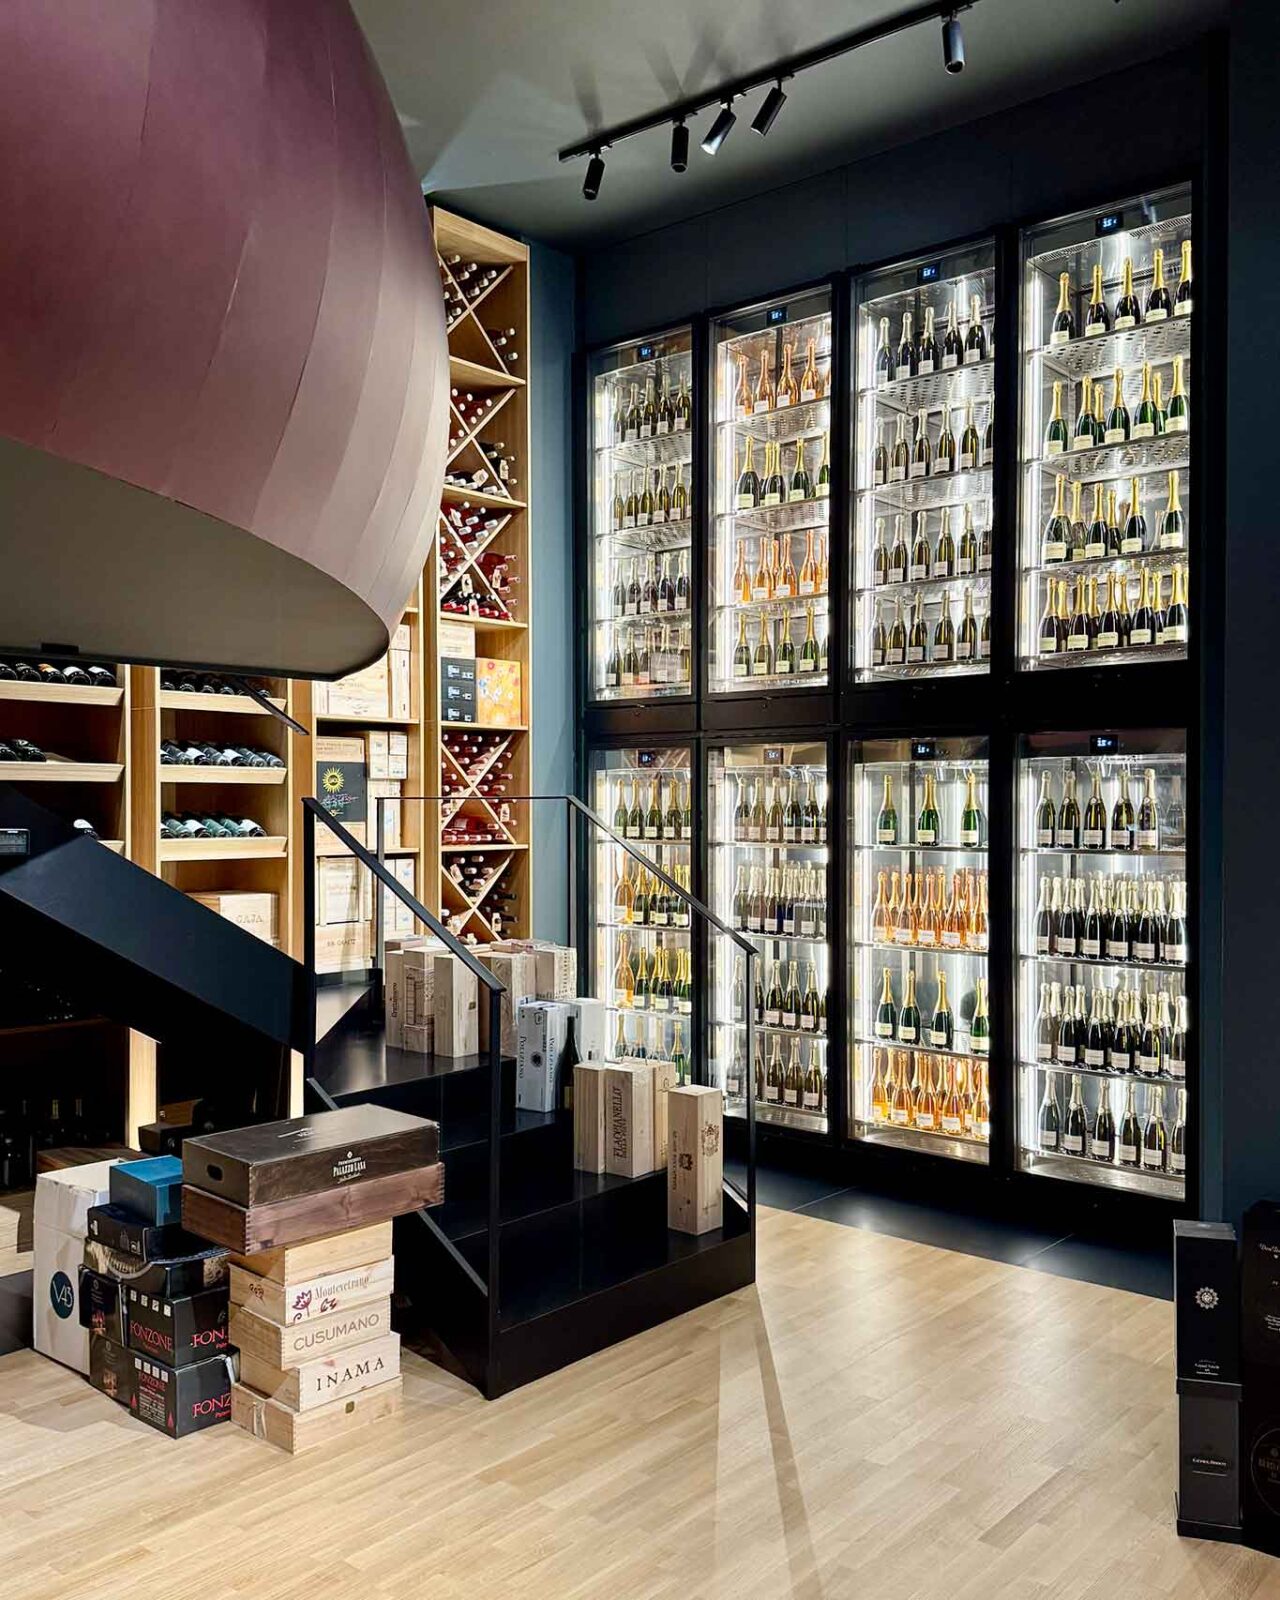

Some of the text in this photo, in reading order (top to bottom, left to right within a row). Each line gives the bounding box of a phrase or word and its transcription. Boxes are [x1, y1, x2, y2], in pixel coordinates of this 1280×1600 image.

[130, 1320, 173, 1352] FONZONE
[191, 1328, 228, 1348] FON
[293, 1313, 380, 1351] CUSUMANO
[316, 1357, 385, 1391] INAMA
